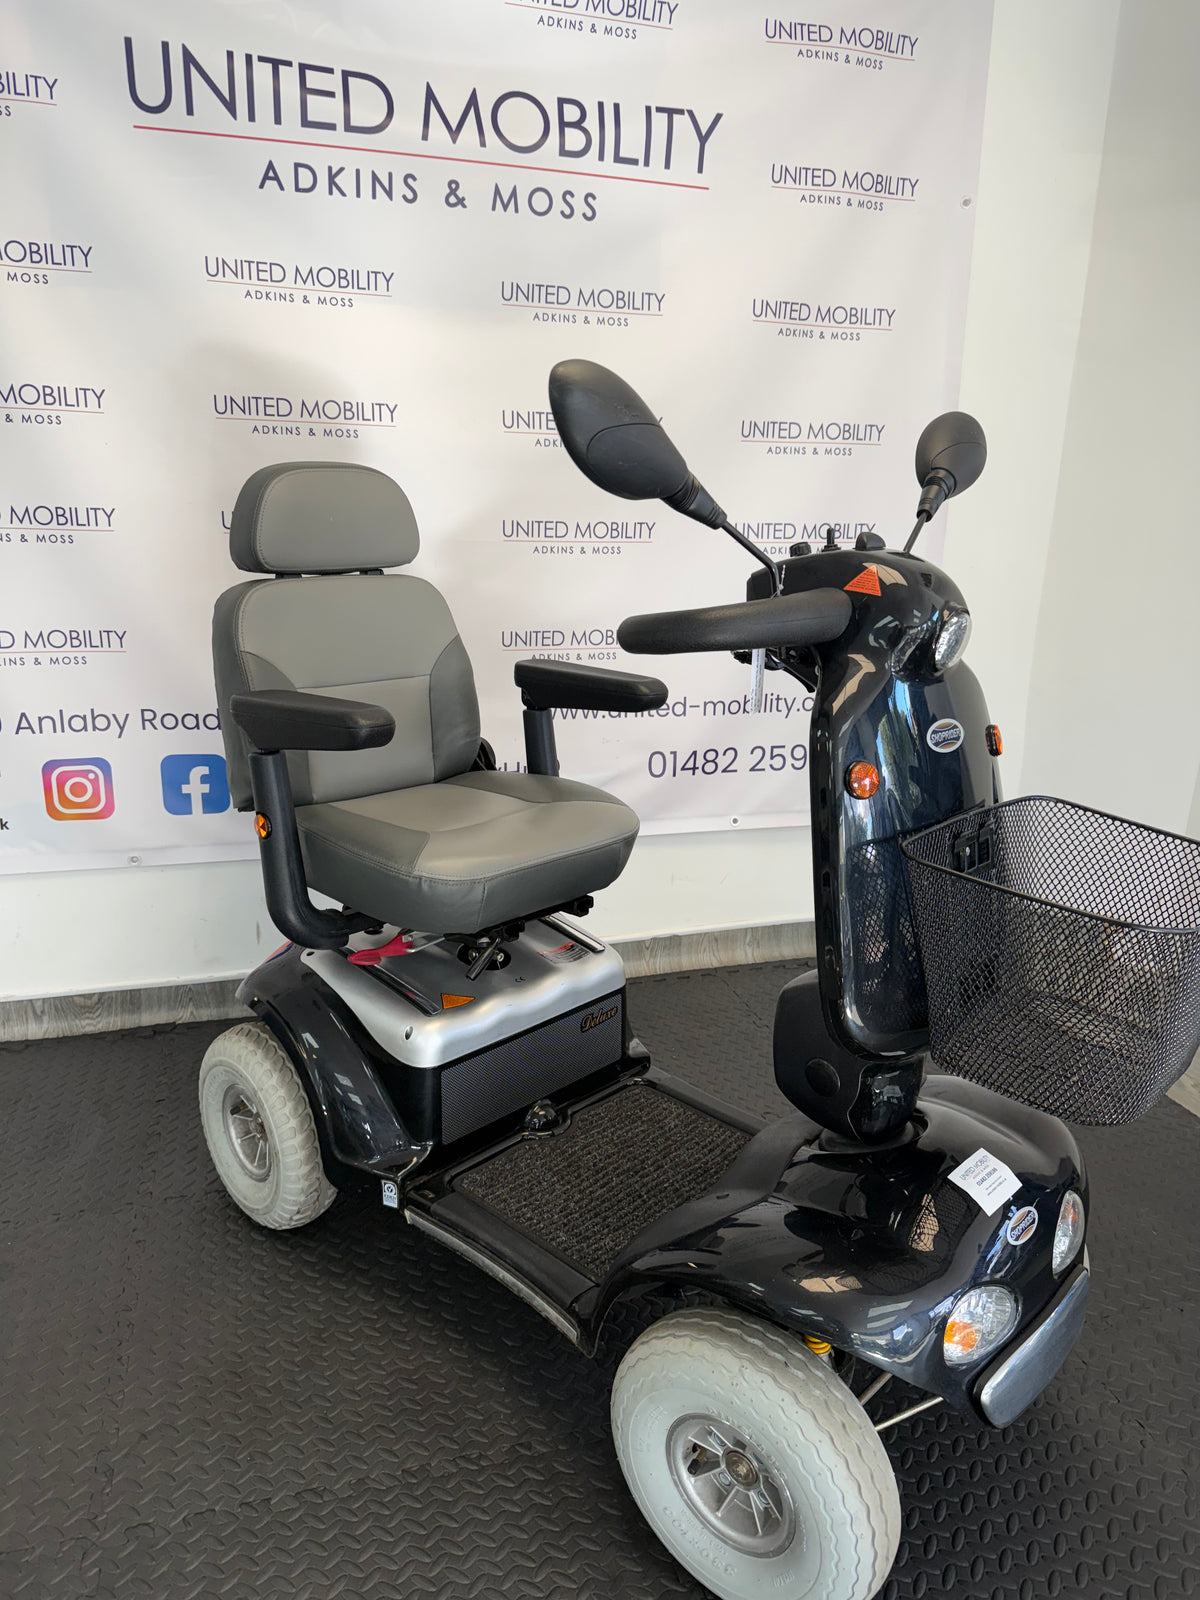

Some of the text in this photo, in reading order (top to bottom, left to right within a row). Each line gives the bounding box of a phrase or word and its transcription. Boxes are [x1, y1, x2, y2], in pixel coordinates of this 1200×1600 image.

[586, 0, 679, 24] MOBILITY
[537, 15, 636, 39] ADKINS & MOSS
[766, 18, 918, 56] UNITED MOBILITY
[797, 49, 883, 70] ADKINS & MOSS
[124, 36, 723, 174] UNITED MOBILITY
[772, 163, 919, 197] UNITED MOBILITY
[258, 160, 596, 221] ADKINS & MOSS
[800, 194, 883, 211] ADKINS & MOSS
[0, 240, 92, 267] OBILITY
[7, 272, 48, 284] MOSS
[205, 256, 394, 292] UNITED MOBILITY
[245, 288, 353, 307] ADKINS & MOSS
[502, 281, 665, 312] UNITED MOBILITY
[533, 312, 628, 327] ADKINS & MOSS
[753, 299, 896, 327] UNITED MOBILITY
[778, 328, 860, 341] ADKINS & MOSS
[0, 384, 105, 408] MOBILITY
[214, 395, 398, 422] UNITED MOBILITY
[5, 414, 61, 425] & MOSS
[502, 410, 556, 430] UNITE
[252, 425, 358, 438] ADKINS & MOSS
[741, 420, 885, 445] UNITED MOBILITY
[535, 438, 563, 448] ADKI
[767, 446, 853, 457] ADKINS & MOSS
[10, 505, 115, 527] MOBILITY
[20, 534, 28, 542] &
[36, 534, 73, 544] MOSS
[503, 520, 656, 539] UNITED MOBILITY
[533, 546, 622, 555] ADKINS & MOSS
[24, 630, 127, 648] MOBILITY
[502, 629, 617, 647] UNITED MOB
[0, 656, 87, 666] INS & MOSS
[576, 653, 582, 661] &
[588, 652, 616, 660] MOSS
[15, 708, 129, 739] Anlaby
[141, 708, 221, 730] Road
[648, 744, 807, 778] 01482 259
